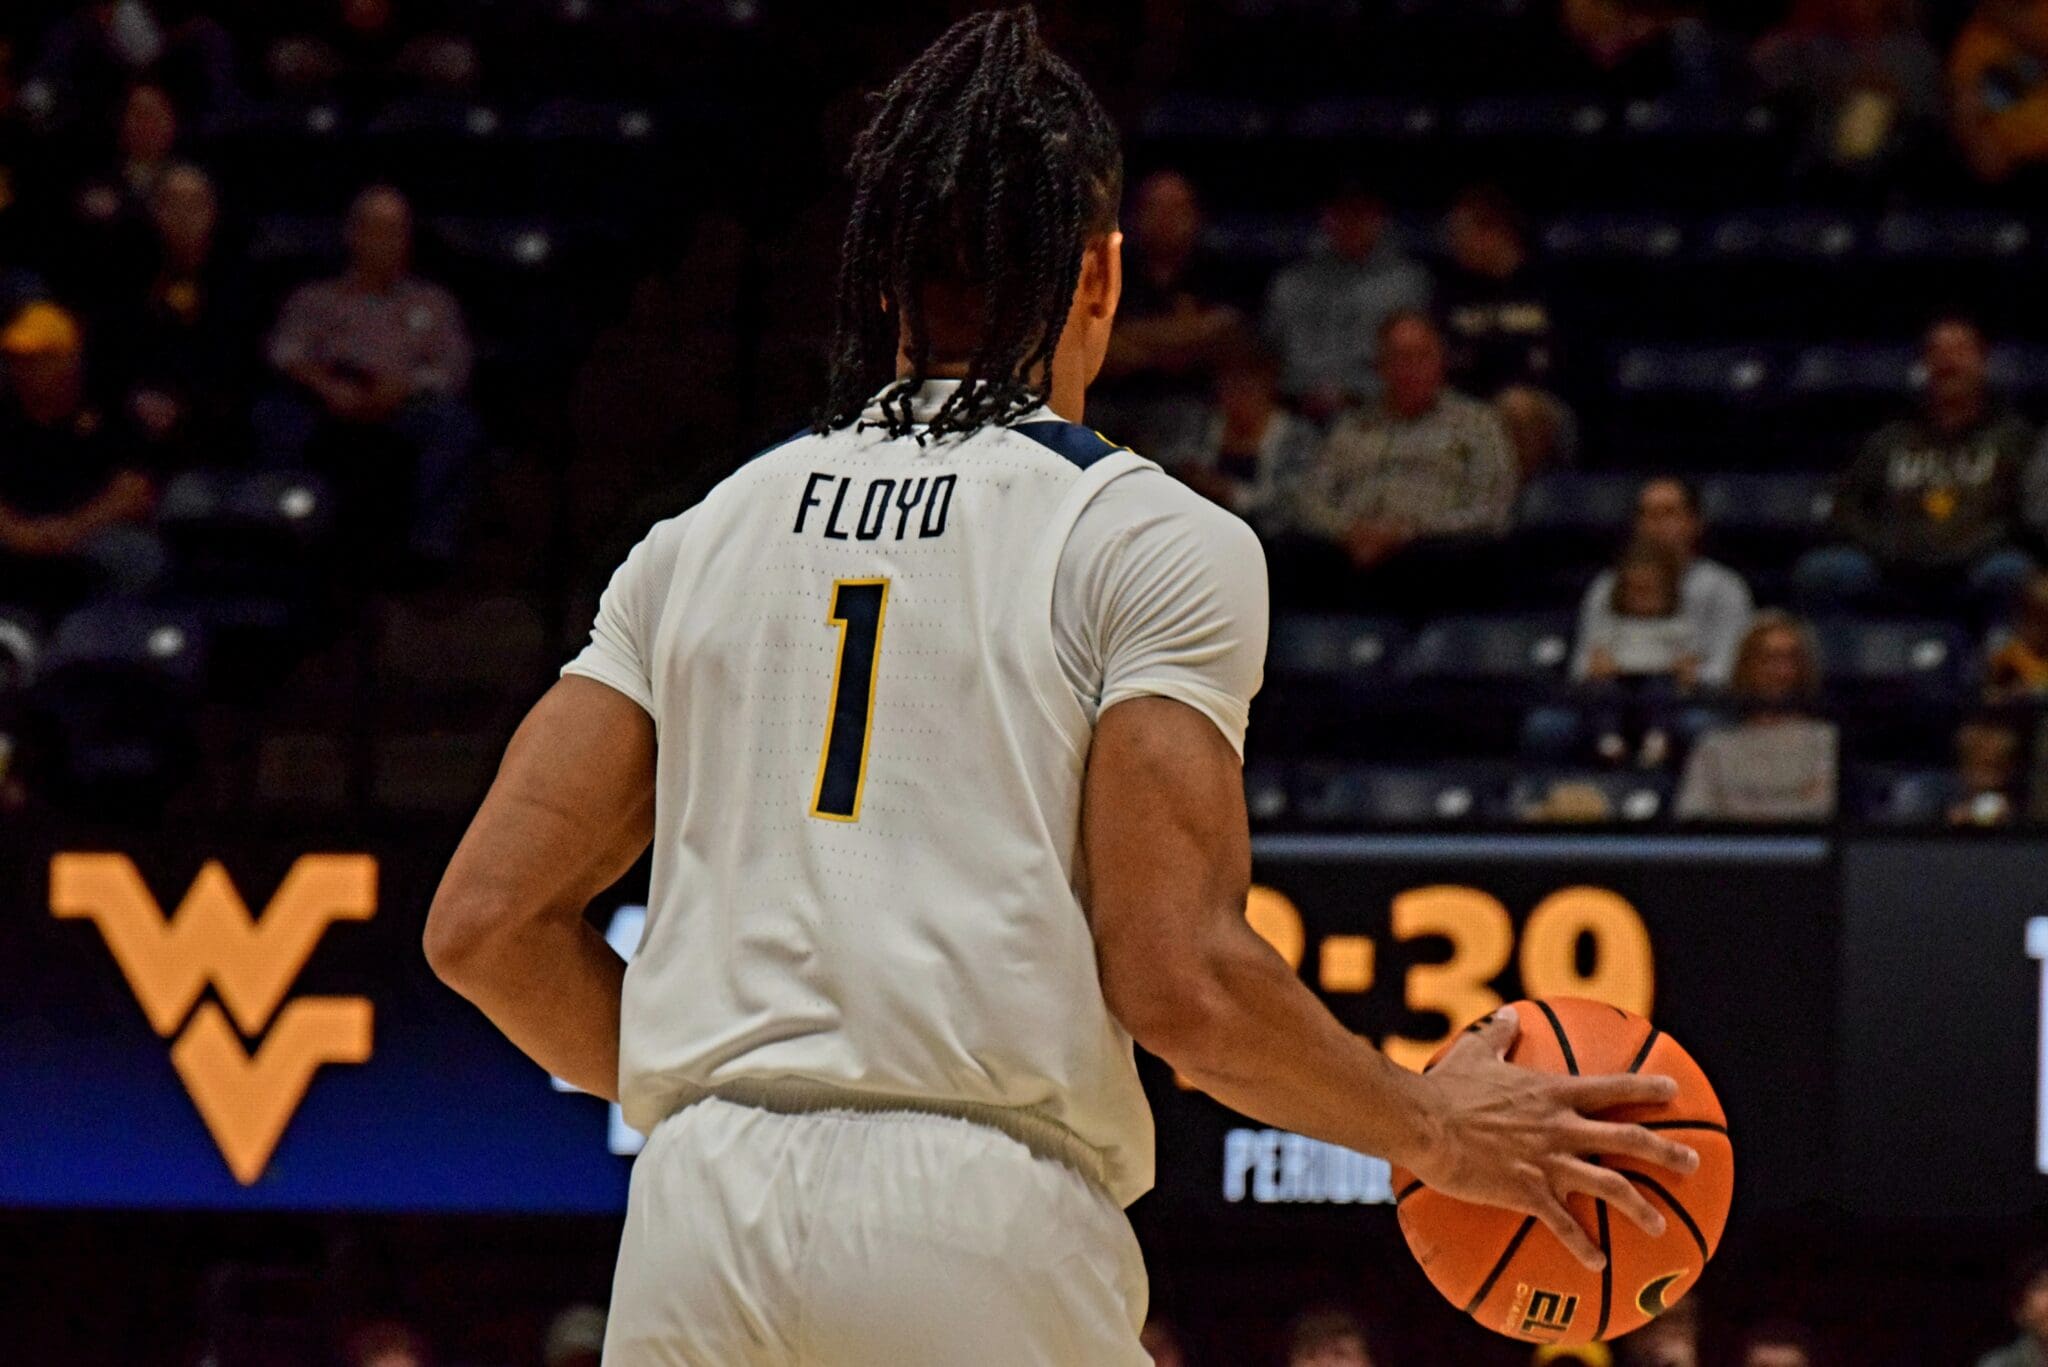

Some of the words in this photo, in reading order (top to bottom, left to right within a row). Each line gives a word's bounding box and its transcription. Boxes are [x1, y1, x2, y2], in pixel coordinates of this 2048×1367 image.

[793, 472, 957, 540] FLOYD
[809, 578, 890, 823] 1
[1245, 884, 1655, 1076] :39
